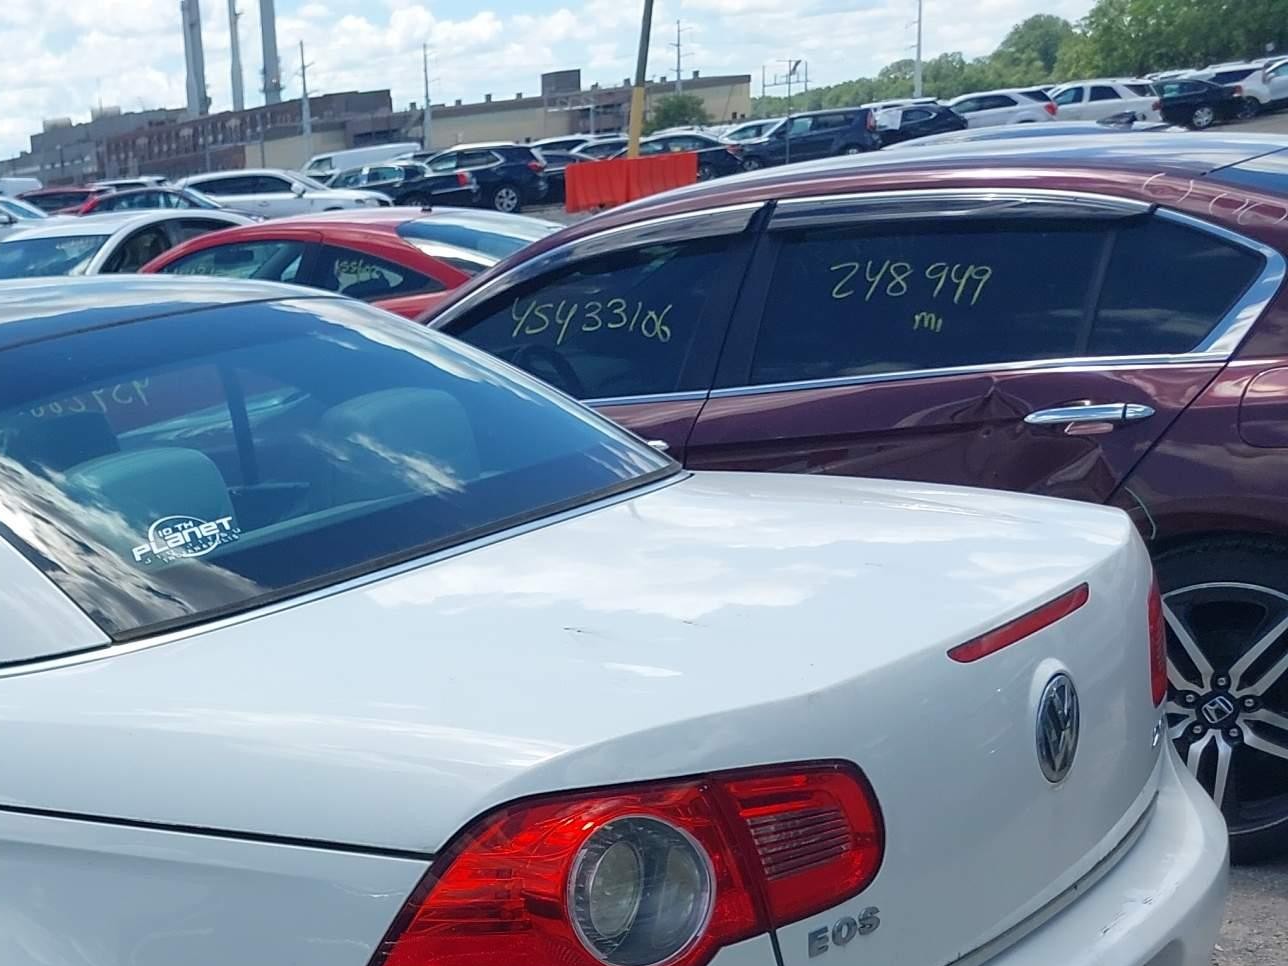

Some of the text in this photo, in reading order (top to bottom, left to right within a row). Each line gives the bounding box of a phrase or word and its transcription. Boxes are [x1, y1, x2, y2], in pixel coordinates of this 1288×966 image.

[830, 260, 993, 305] 248 949
[512, 297, 673, 344] 45433106
[174, 520, 194, 532] TH
[808, 906, 881, 959] EOS
